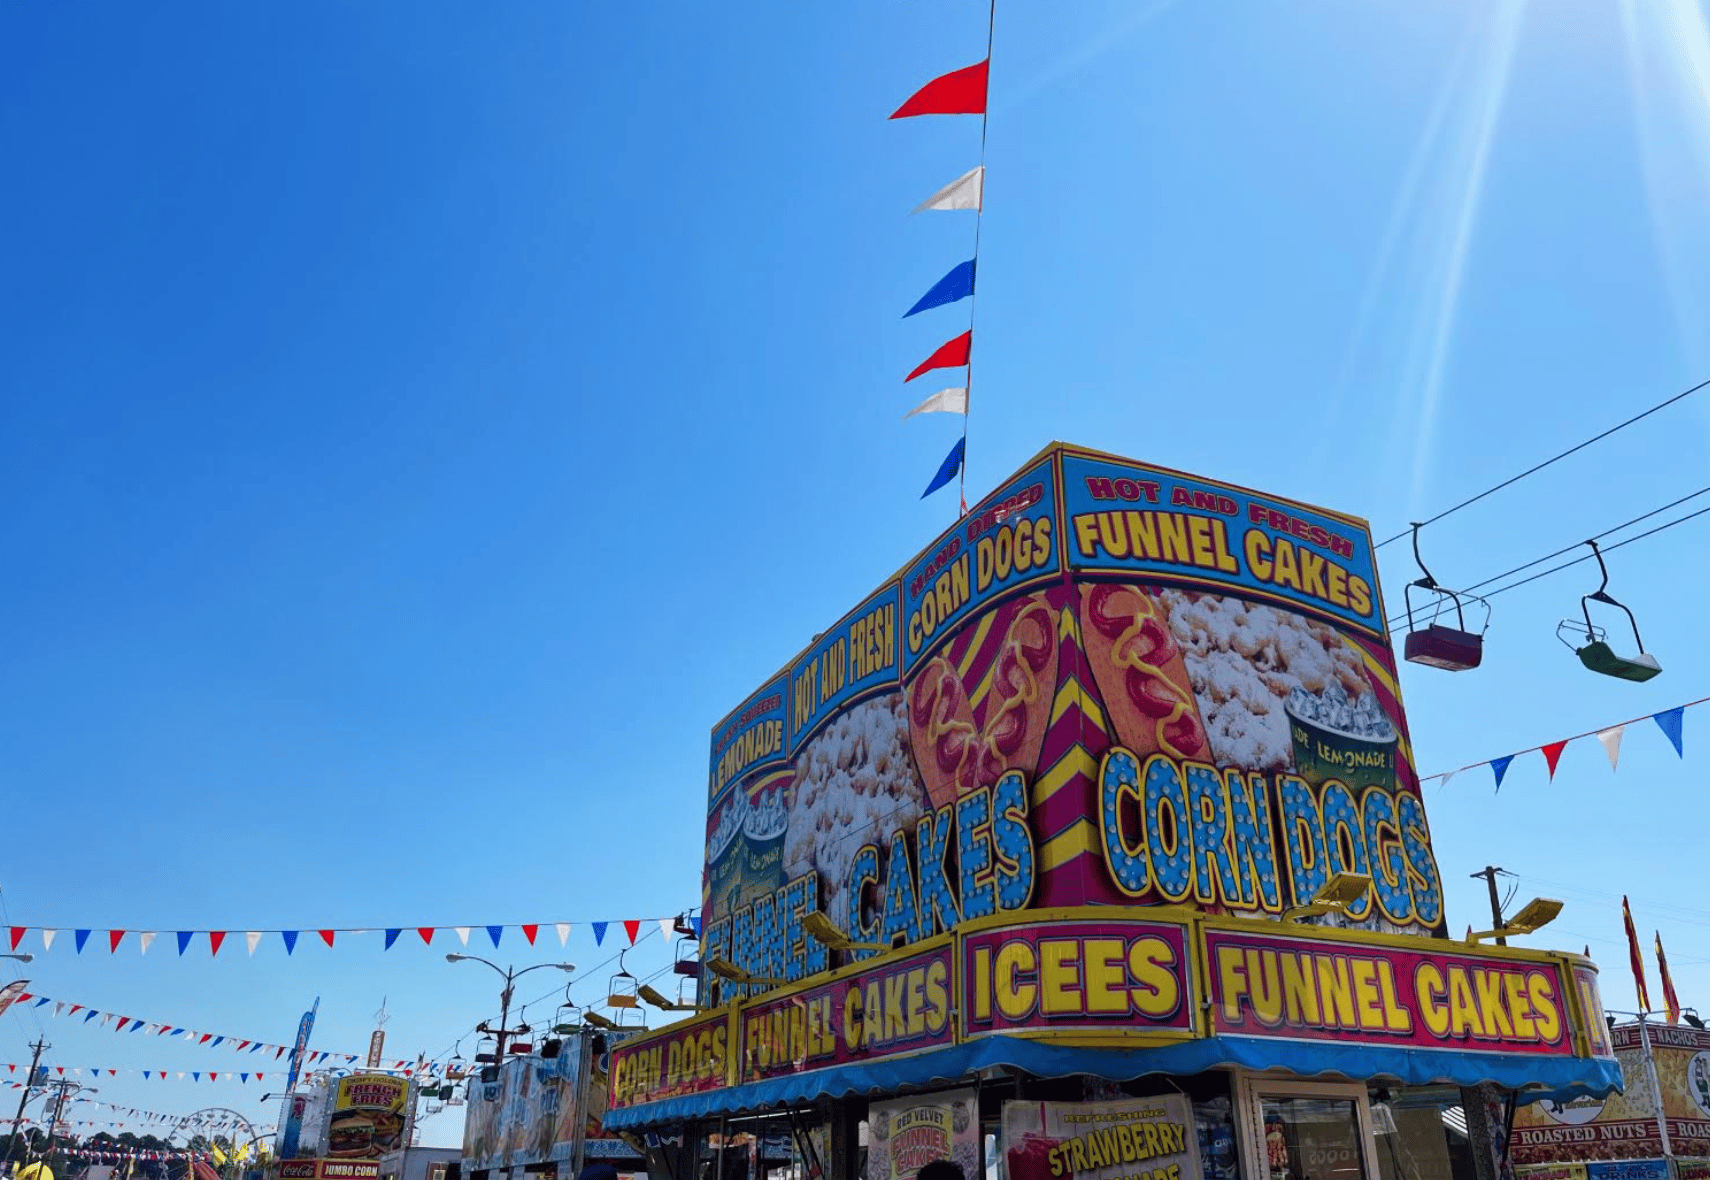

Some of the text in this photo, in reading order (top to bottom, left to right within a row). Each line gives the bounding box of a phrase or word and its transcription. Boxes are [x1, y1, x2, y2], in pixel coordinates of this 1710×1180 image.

[1085, 476, 1354, 560] HOT AND FRESH
[908, 516, 1052, 656] CORN DOGS
[910, 536, 962, 600] HAND
[1073, 511, 1374, 618] FUNNEL CAKES
[794, 601, 895, 735] HOT AND FRESH
[711, 719, 783, 799] LEMONADE
[1317, 741, 1386, 769] LEMONADE
[849, 768, 1035, 963] CAKES
[1099, 745, 1445, 929] CORN DOGS
[973, 937, 1179, 1020] ICEES
[1216, 945, 1412, 1033] FUNNEL
[1415, 960, 1562, 1044] CAKES
[746, 960, 949, 1073] FUNNEL CAKES
[1655, 1029, 1699, 1047] NACHOS
[344, 1084, 402, 1098] FRENCH
[614, 1025, 726, 1101] CORN DOGS
[351, 1094, 393, 1107] FRIES
[896, 1108, 944, 1131] RED VELVET
[1063, 1108, 1166, 1124] REFRESHING
[1521, 1123, 1647, 1146] ROASTED NUTS
[324, 1164, 378, 1177] JUMBO CORN
[892, 1127, 948, 1157] FUNNEL
[1048, 1122, 1186, 1177] STRAWBERRY
